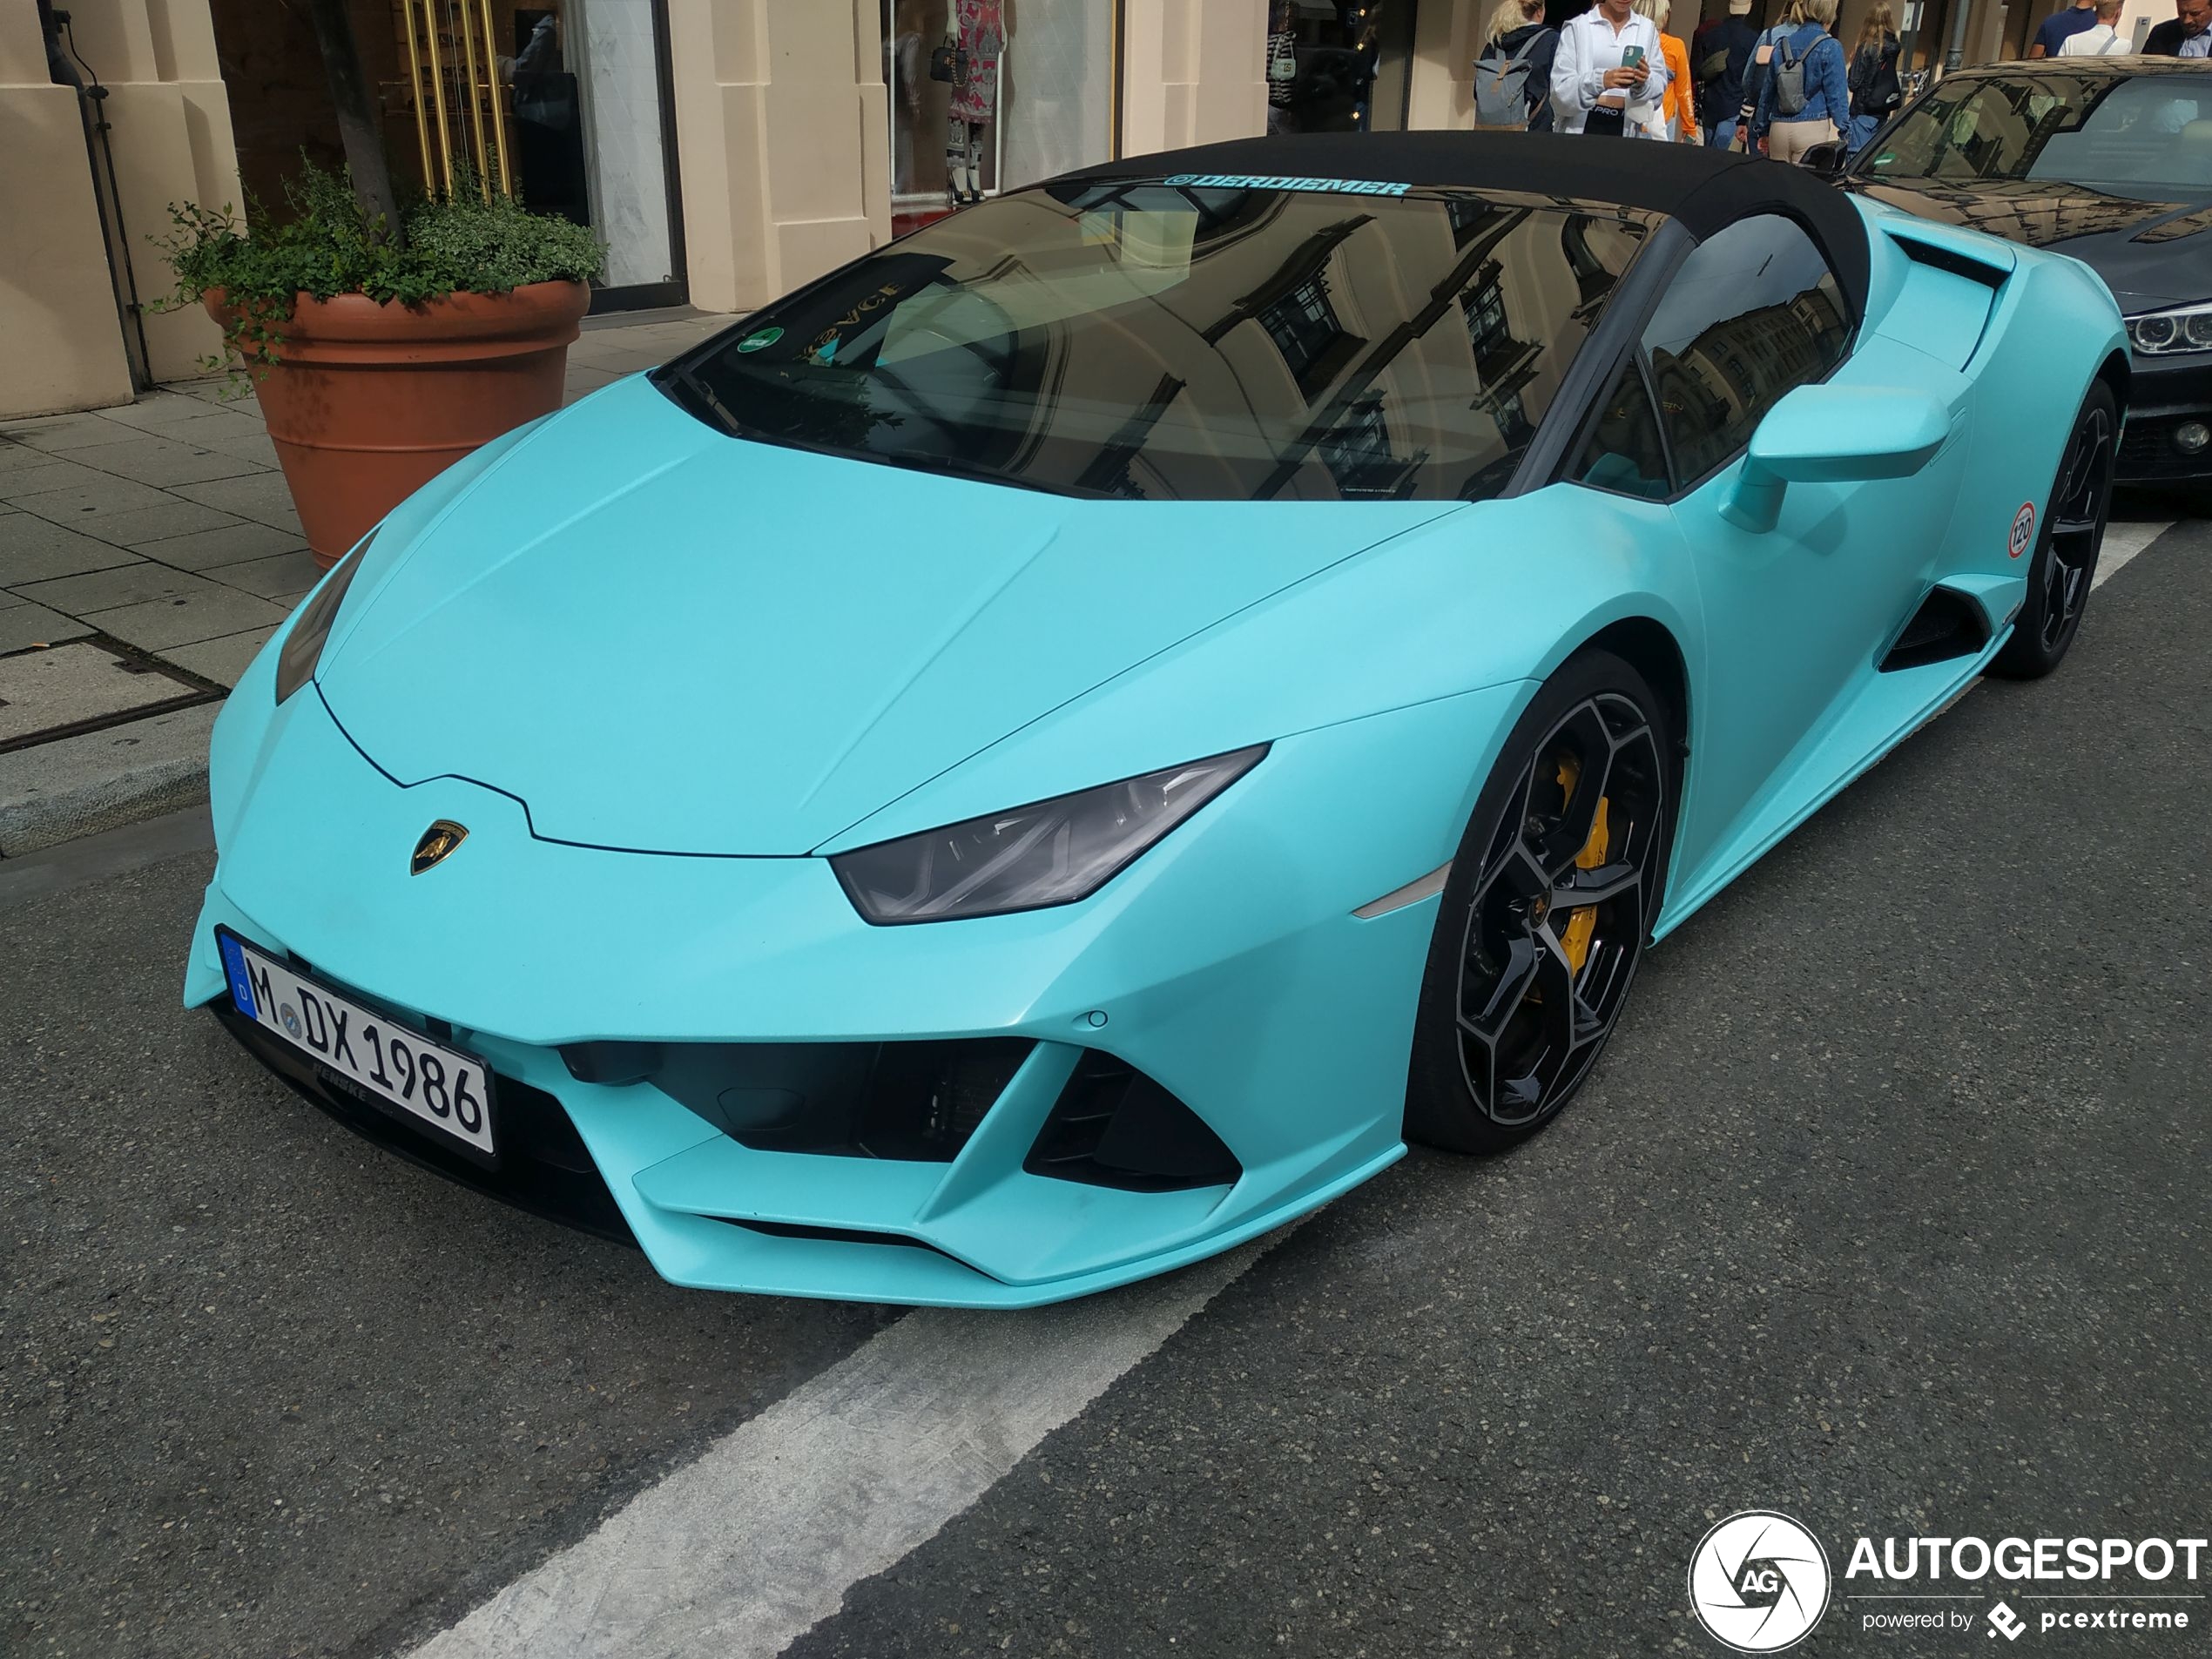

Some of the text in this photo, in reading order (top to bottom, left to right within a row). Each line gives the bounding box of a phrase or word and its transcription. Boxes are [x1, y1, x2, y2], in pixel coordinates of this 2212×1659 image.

[1594, 105, 1619, 117] PRO
[1190, 174, 1413, 196] DERDIEMER
[2013, 517, 2032, 548] 120
[246, 956, 482, 1134] M DX 1986
